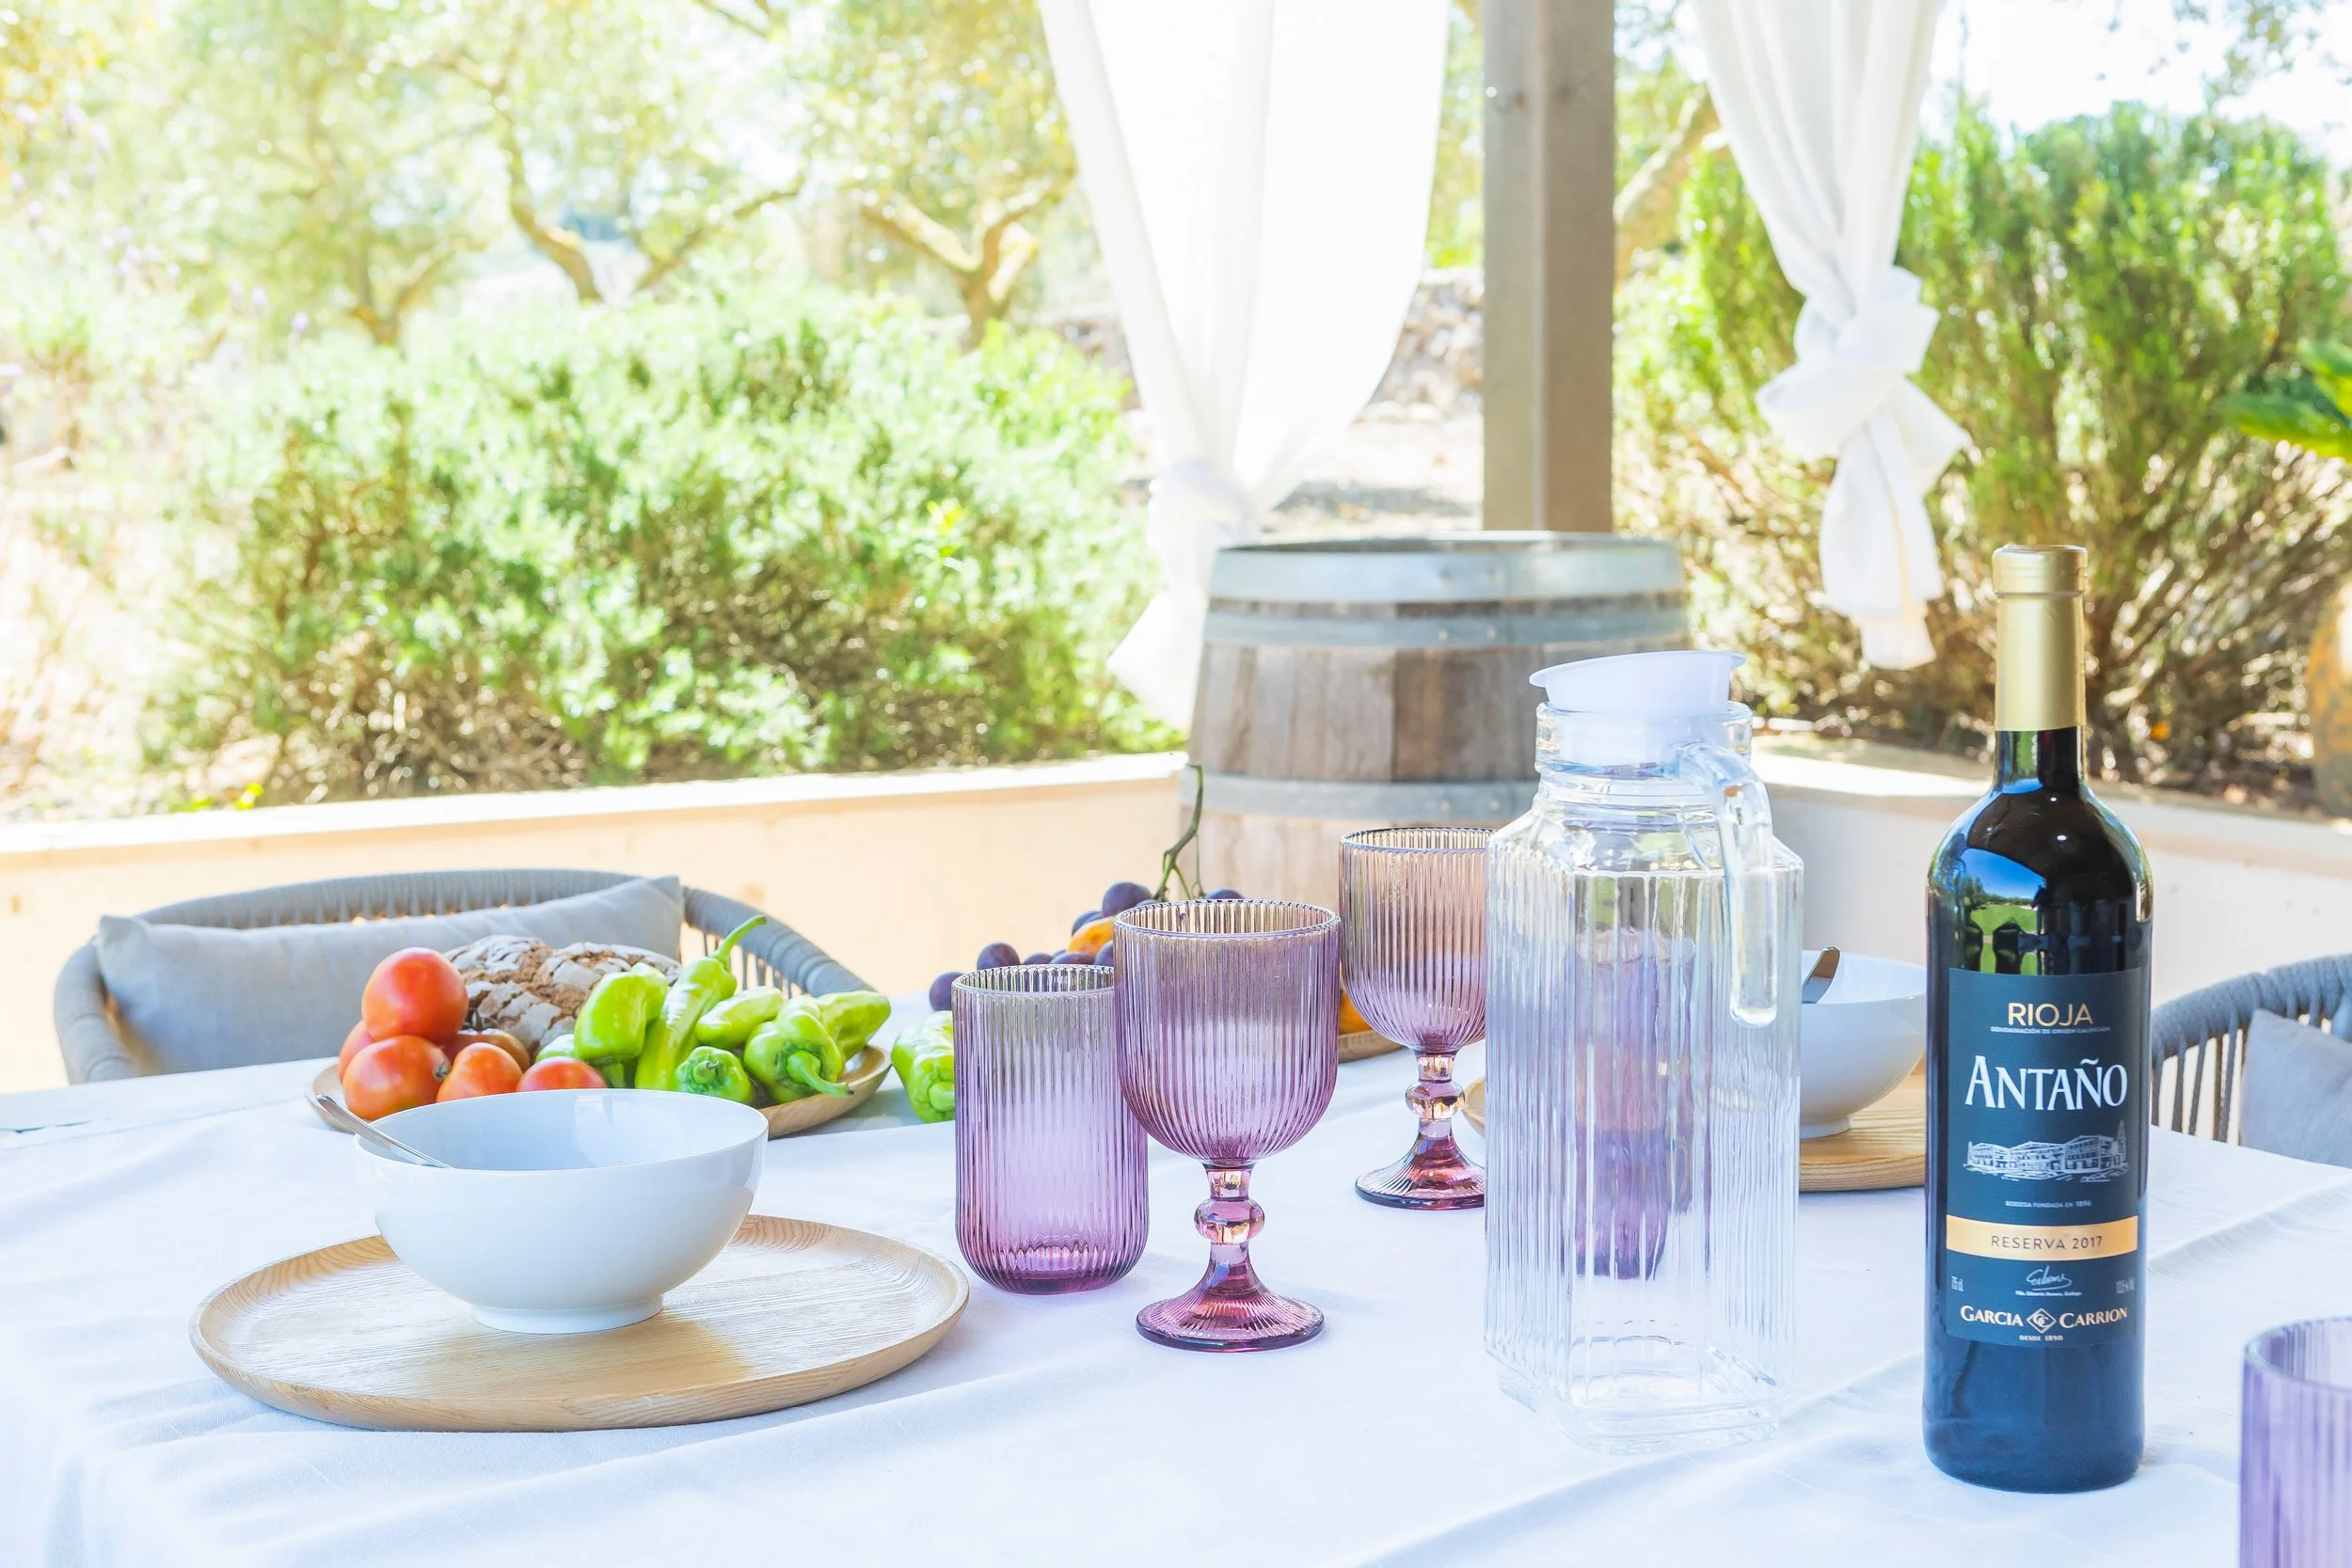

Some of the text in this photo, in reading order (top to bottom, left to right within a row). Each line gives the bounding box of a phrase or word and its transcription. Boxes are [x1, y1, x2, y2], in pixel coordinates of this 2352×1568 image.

[2008, 1002, 2094, 1027] RIOJA
[1964, 1054, 2129, 1111] ANTAÑO
[1991, 1235, 2104, 1250] RESERVA 2017
[1960, 1305, 2025, 1327] GARCIA
[2058, 1307, 2129, 1329] CARRION
